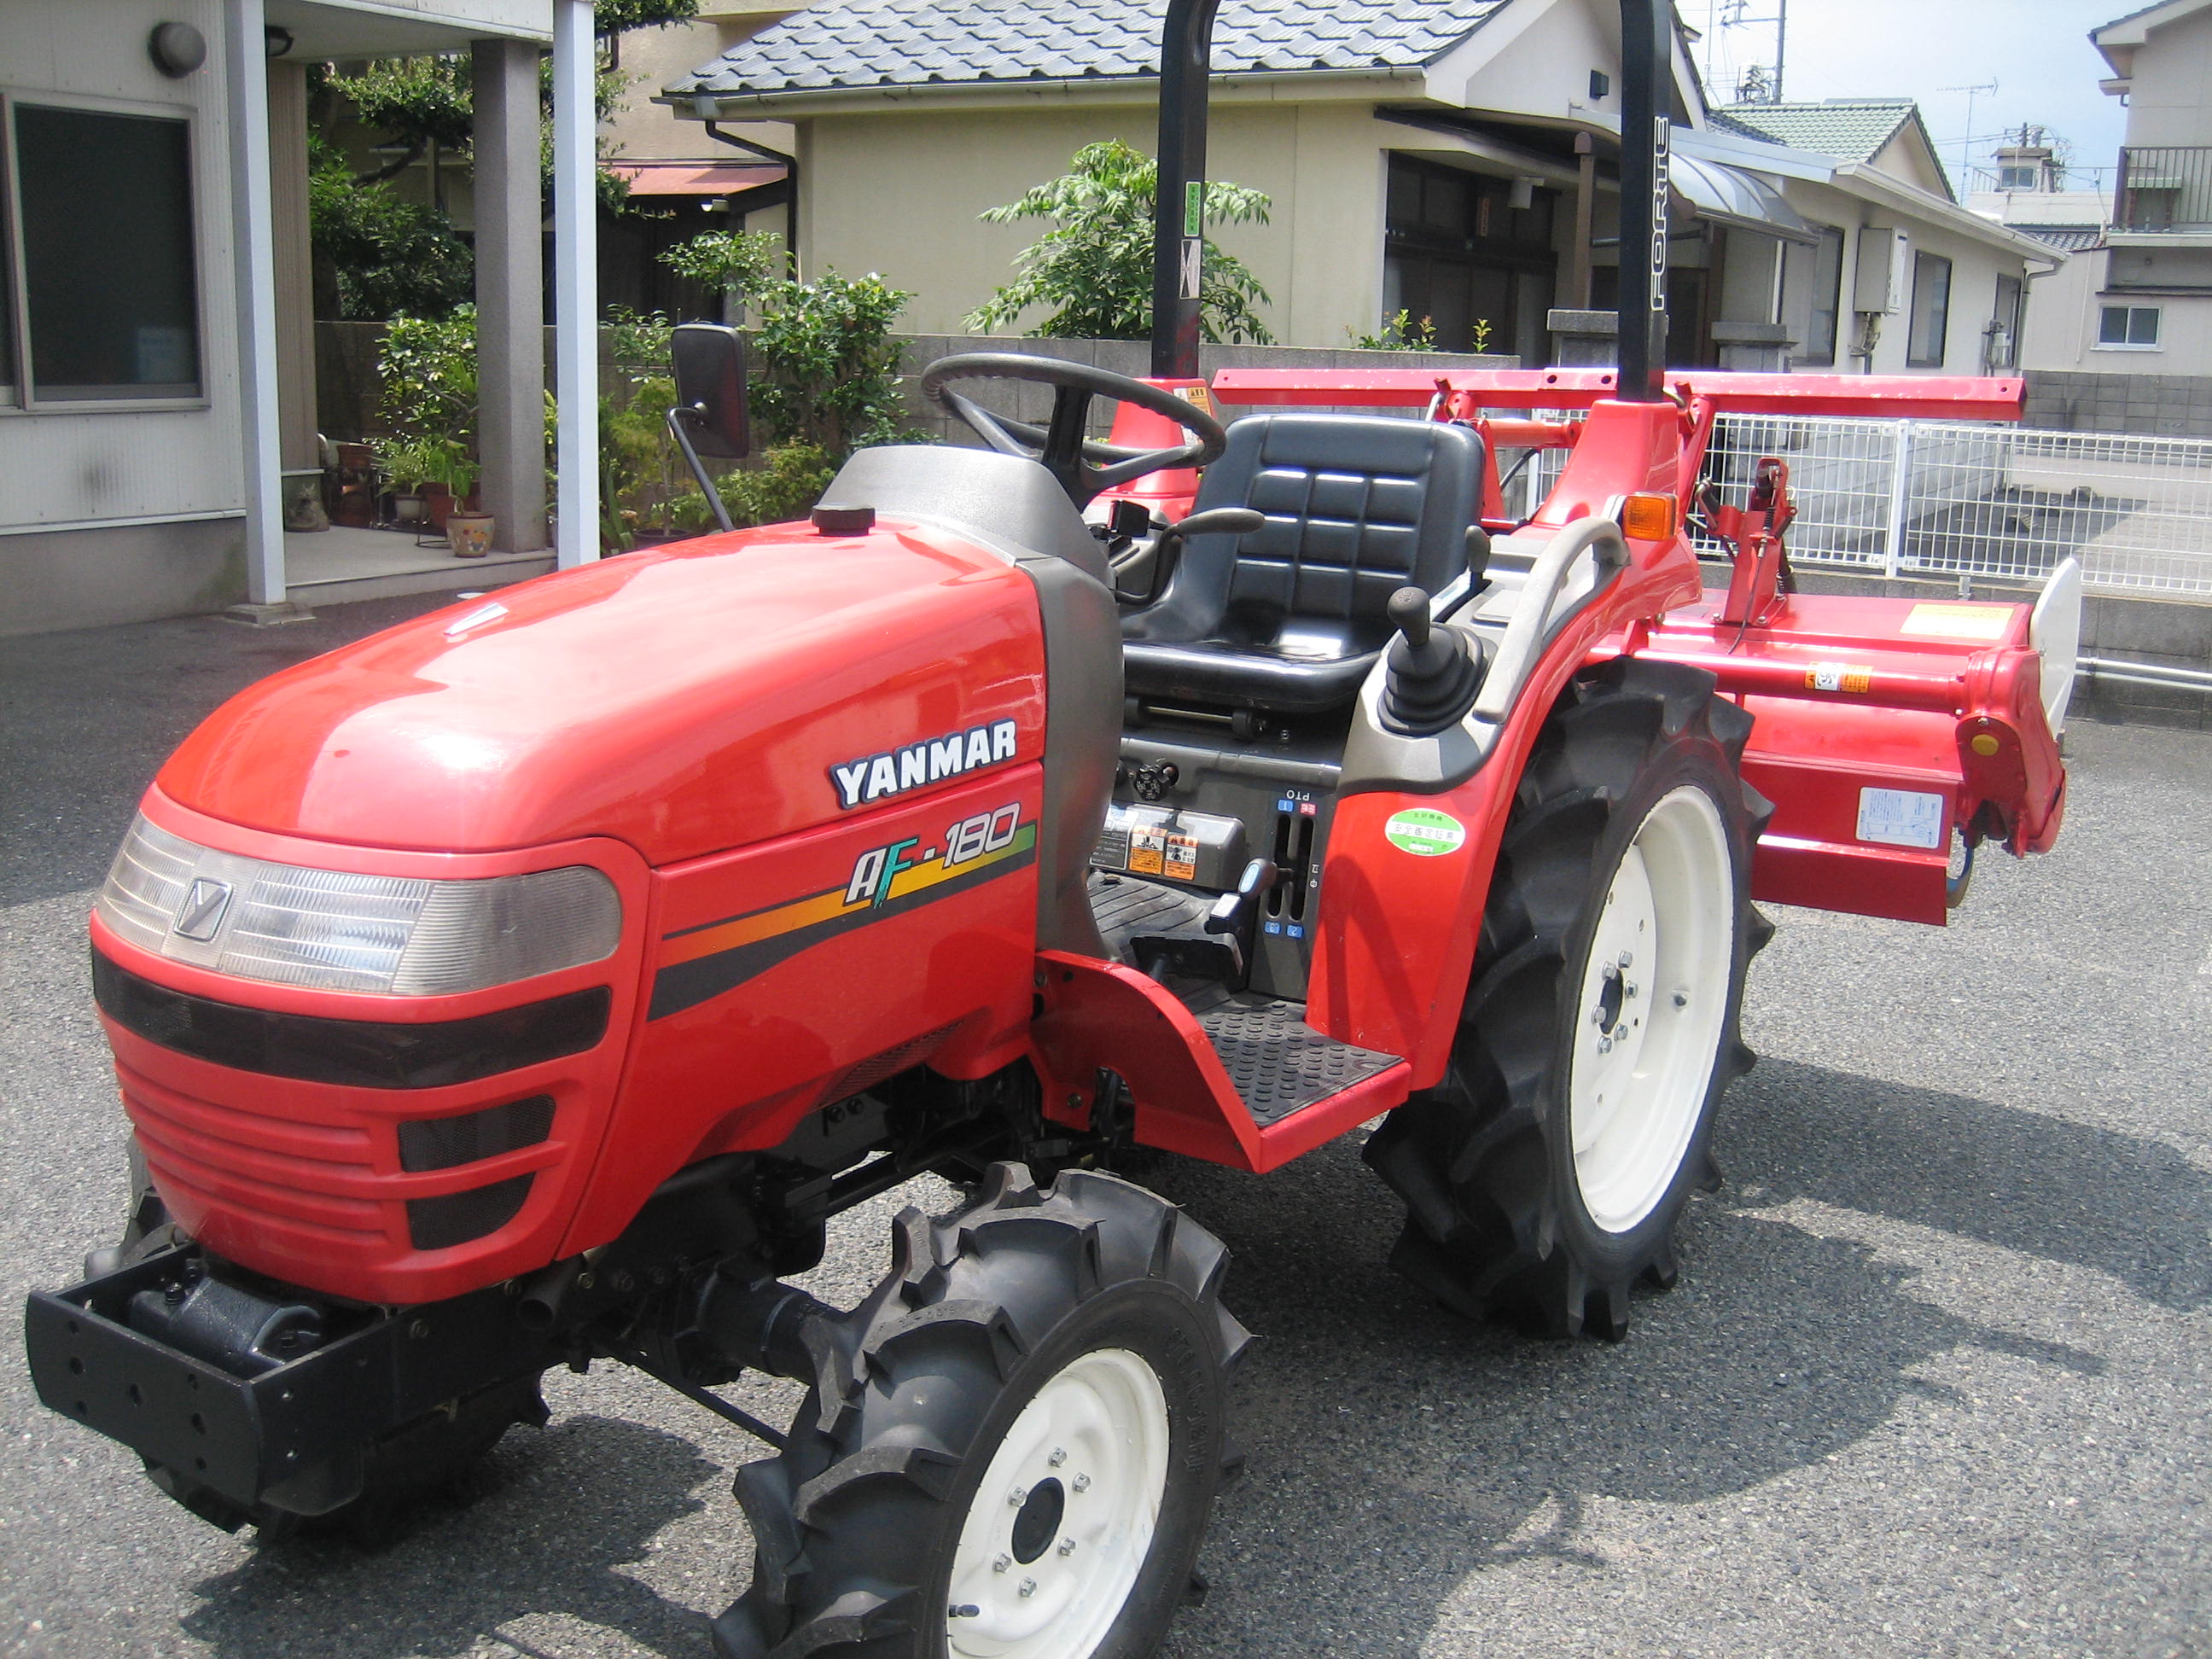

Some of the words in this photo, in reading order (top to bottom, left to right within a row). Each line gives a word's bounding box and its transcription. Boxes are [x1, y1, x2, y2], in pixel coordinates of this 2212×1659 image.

[1650, 115, 1668, 311] FORTE
[833, 719, 1016, 807] YANMAR
[1286, 789, 1310, 801] PTO
